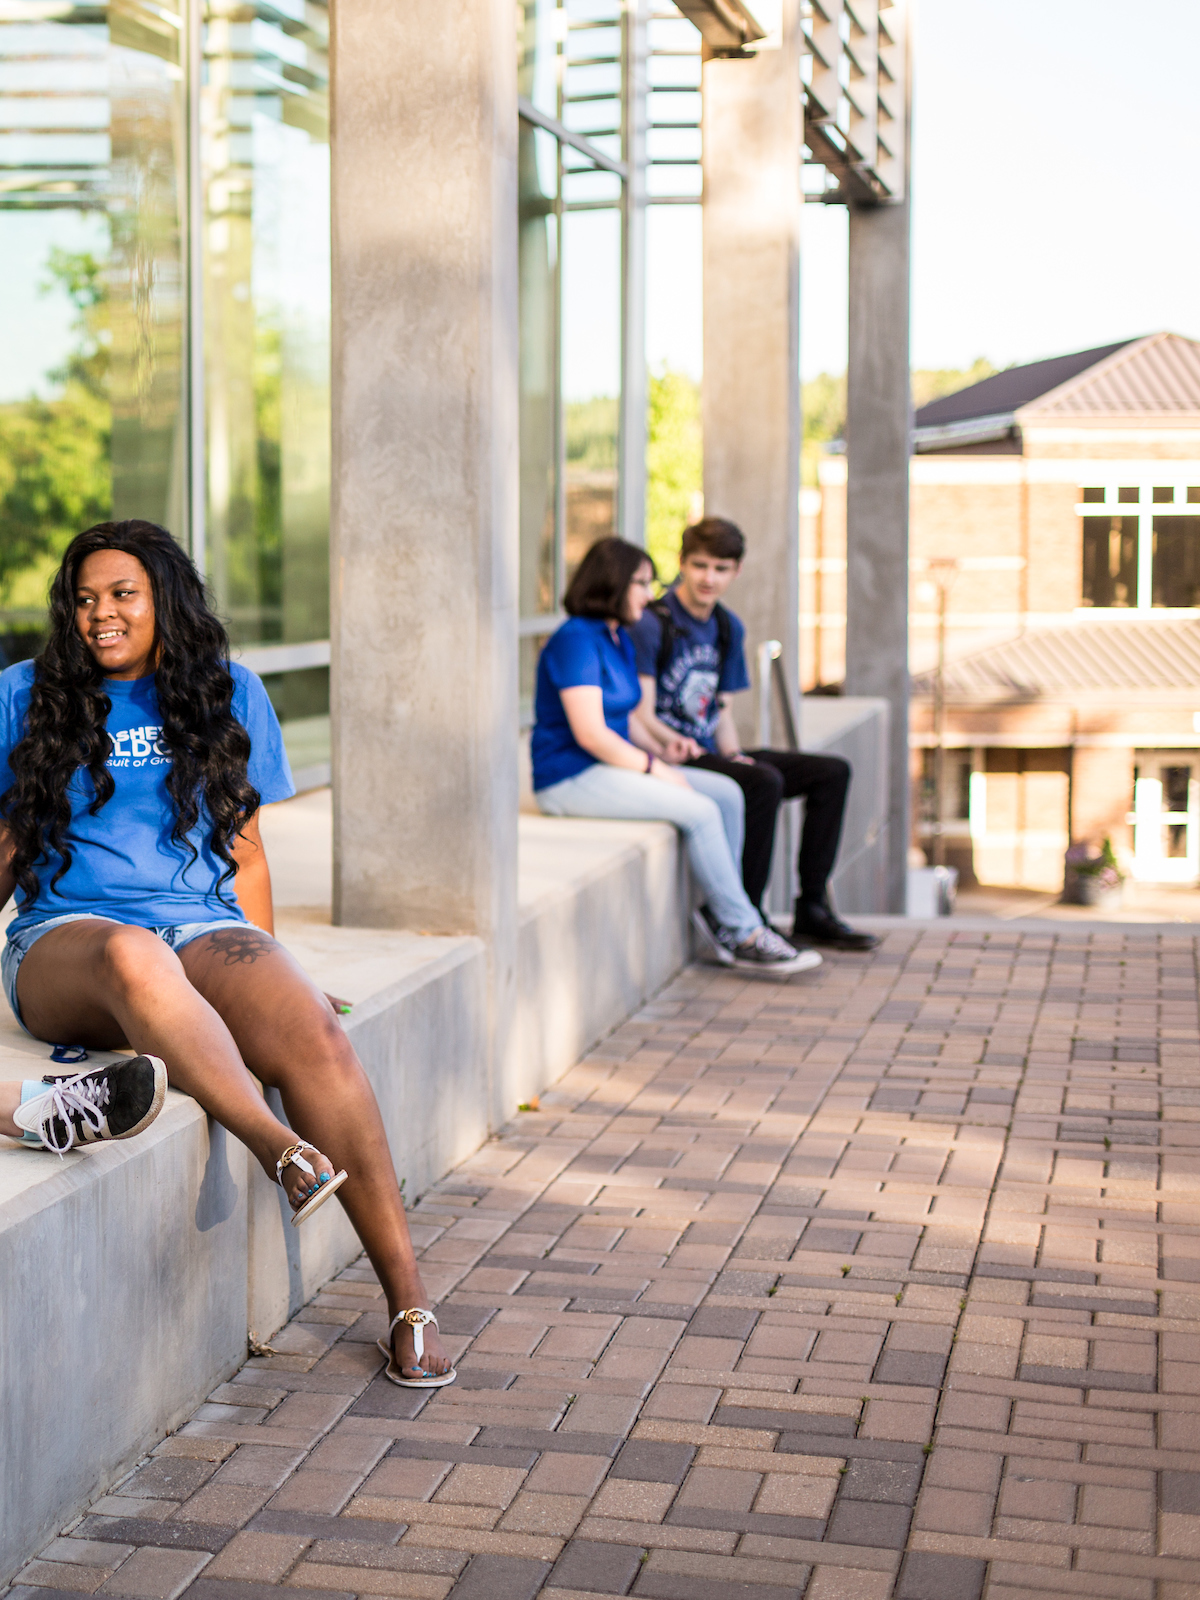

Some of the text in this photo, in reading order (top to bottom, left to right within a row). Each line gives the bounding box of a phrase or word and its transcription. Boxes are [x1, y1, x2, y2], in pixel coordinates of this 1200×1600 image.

[105, 757, 173, 767] suit of Gre
